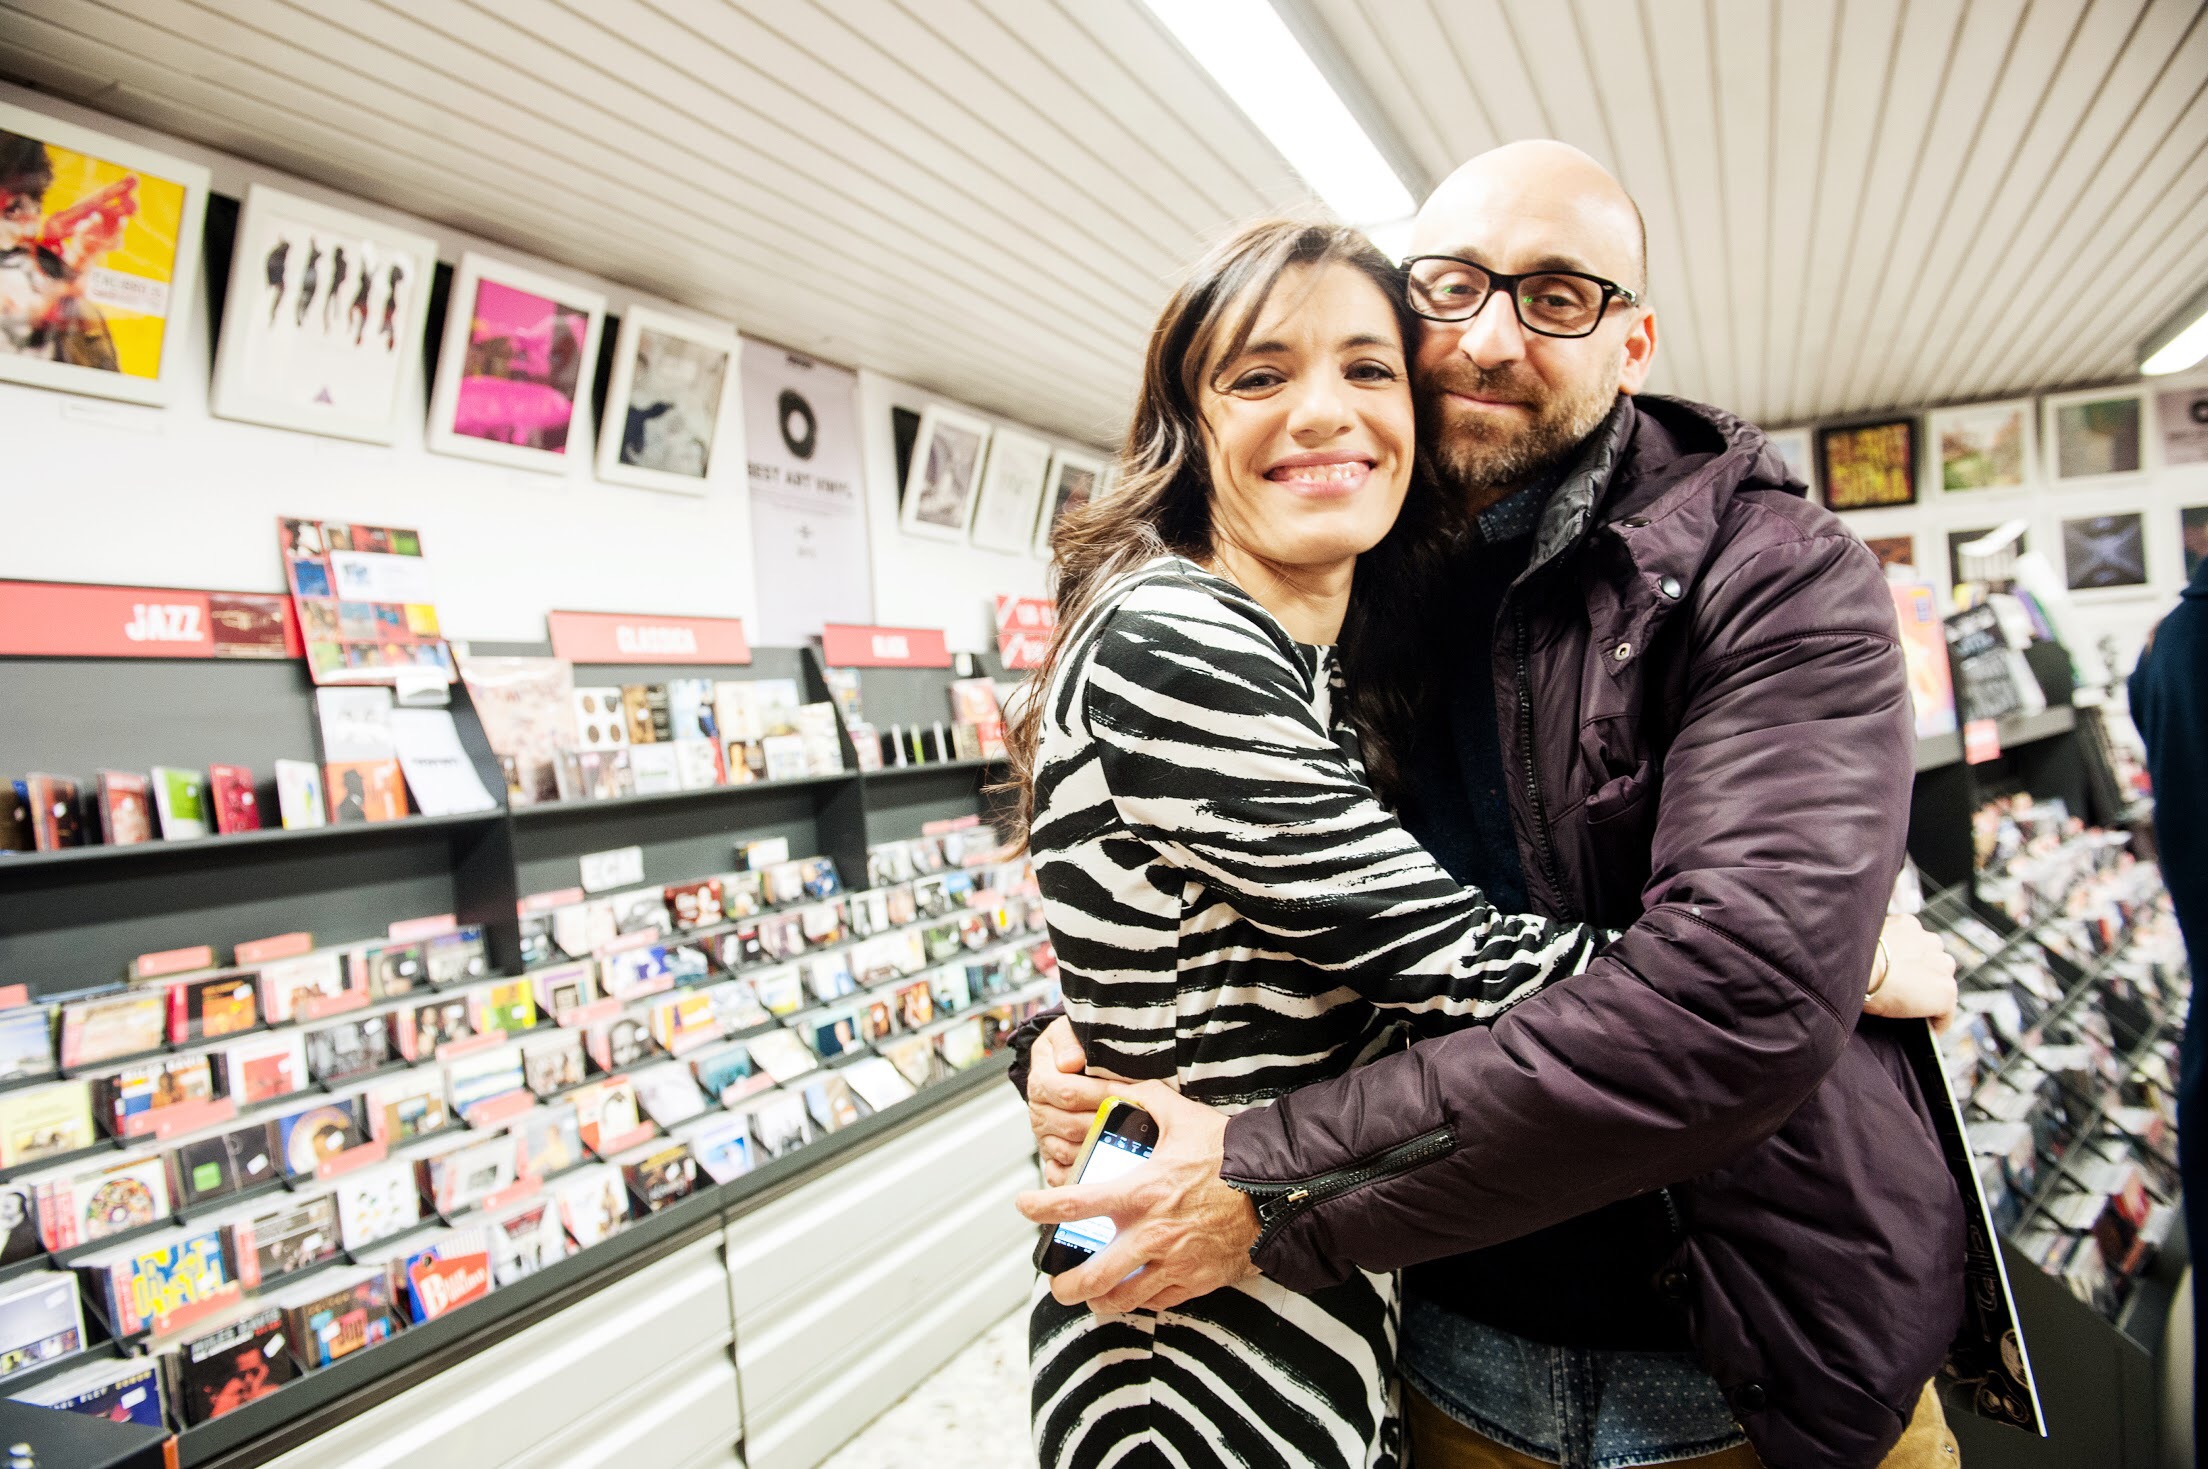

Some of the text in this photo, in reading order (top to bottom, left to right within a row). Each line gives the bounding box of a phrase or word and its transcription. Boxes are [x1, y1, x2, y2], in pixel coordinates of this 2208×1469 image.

[746, 462, 779, 482] BEST
[785, 470, 812, 487] ART
[124, 603, 204, 642] JAZZ
